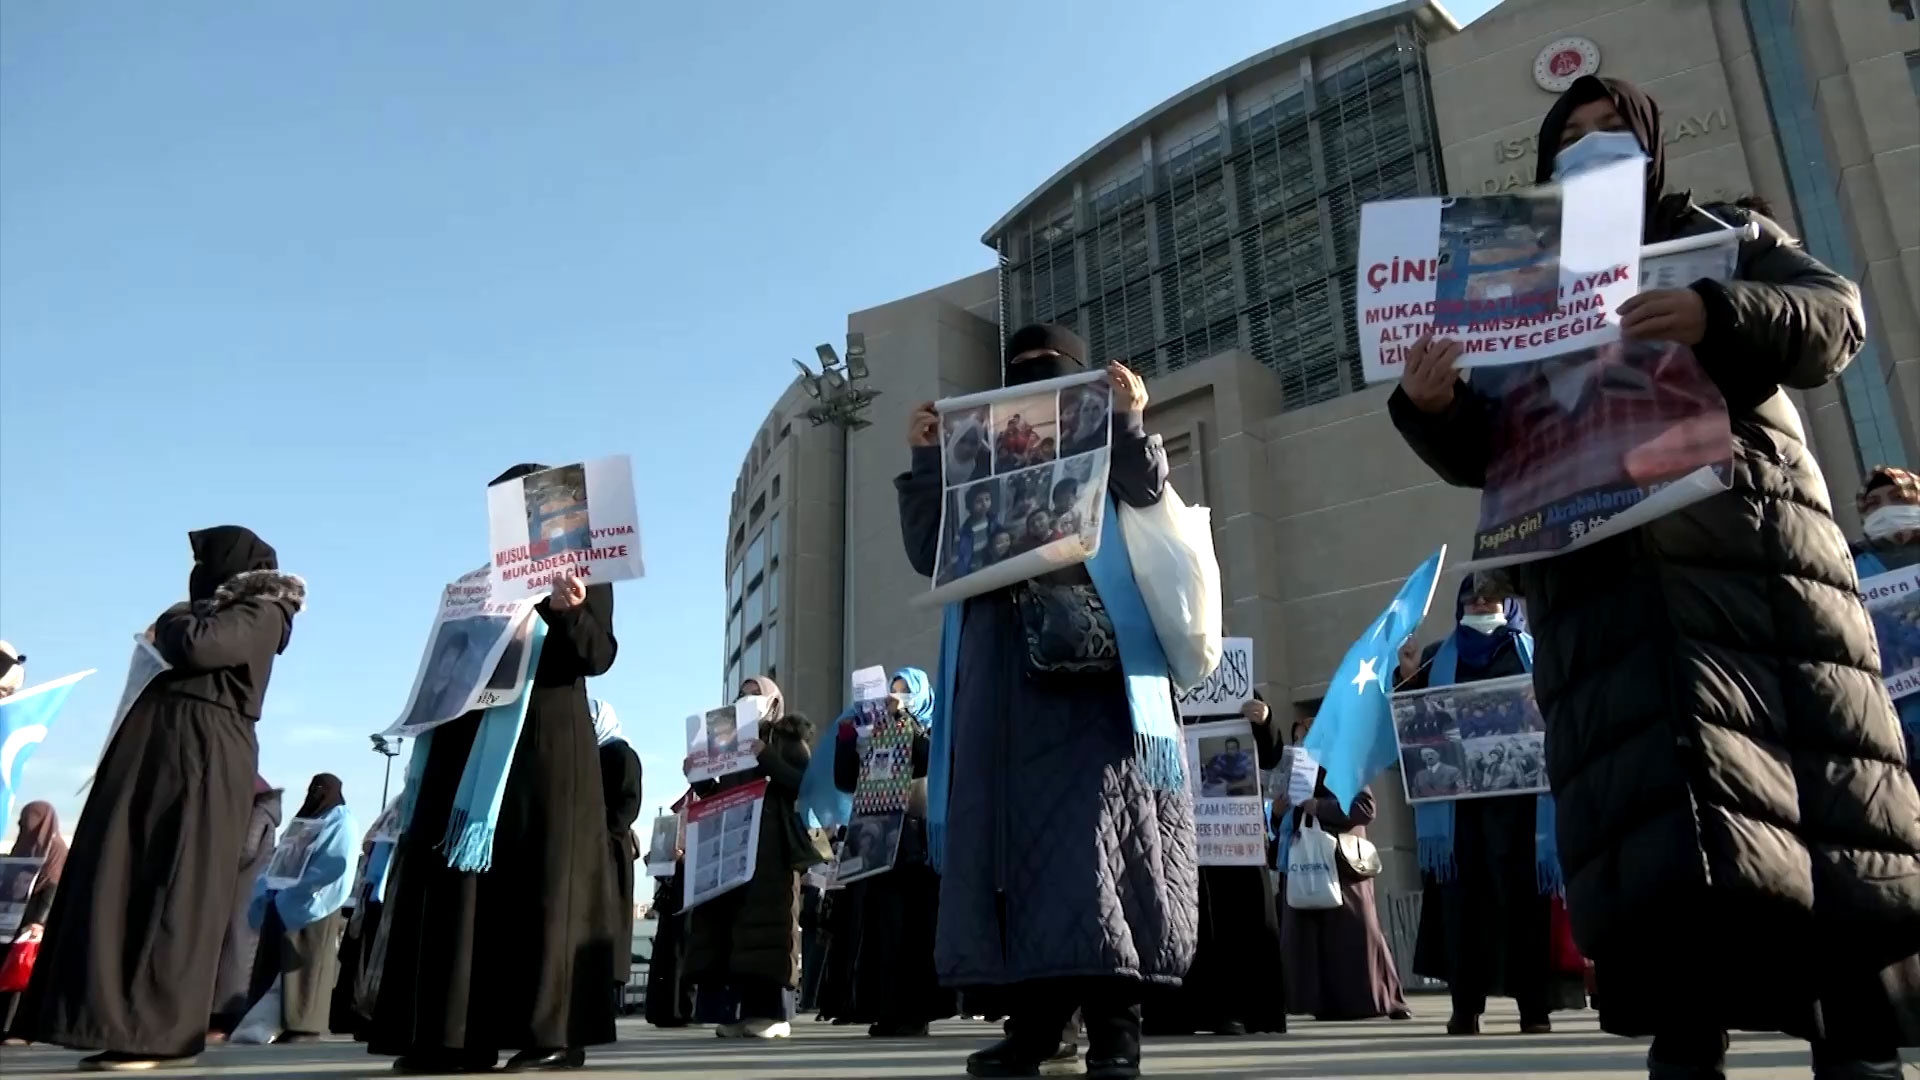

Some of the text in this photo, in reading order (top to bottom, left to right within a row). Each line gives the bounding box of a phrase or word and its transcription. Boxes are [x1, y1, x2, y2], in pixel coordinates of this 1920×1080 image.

[1674, 107, 1729, 143] AYI
[1572, 266, 1629, 294] AYAK
[1859, 581, 1909, 602] odern
